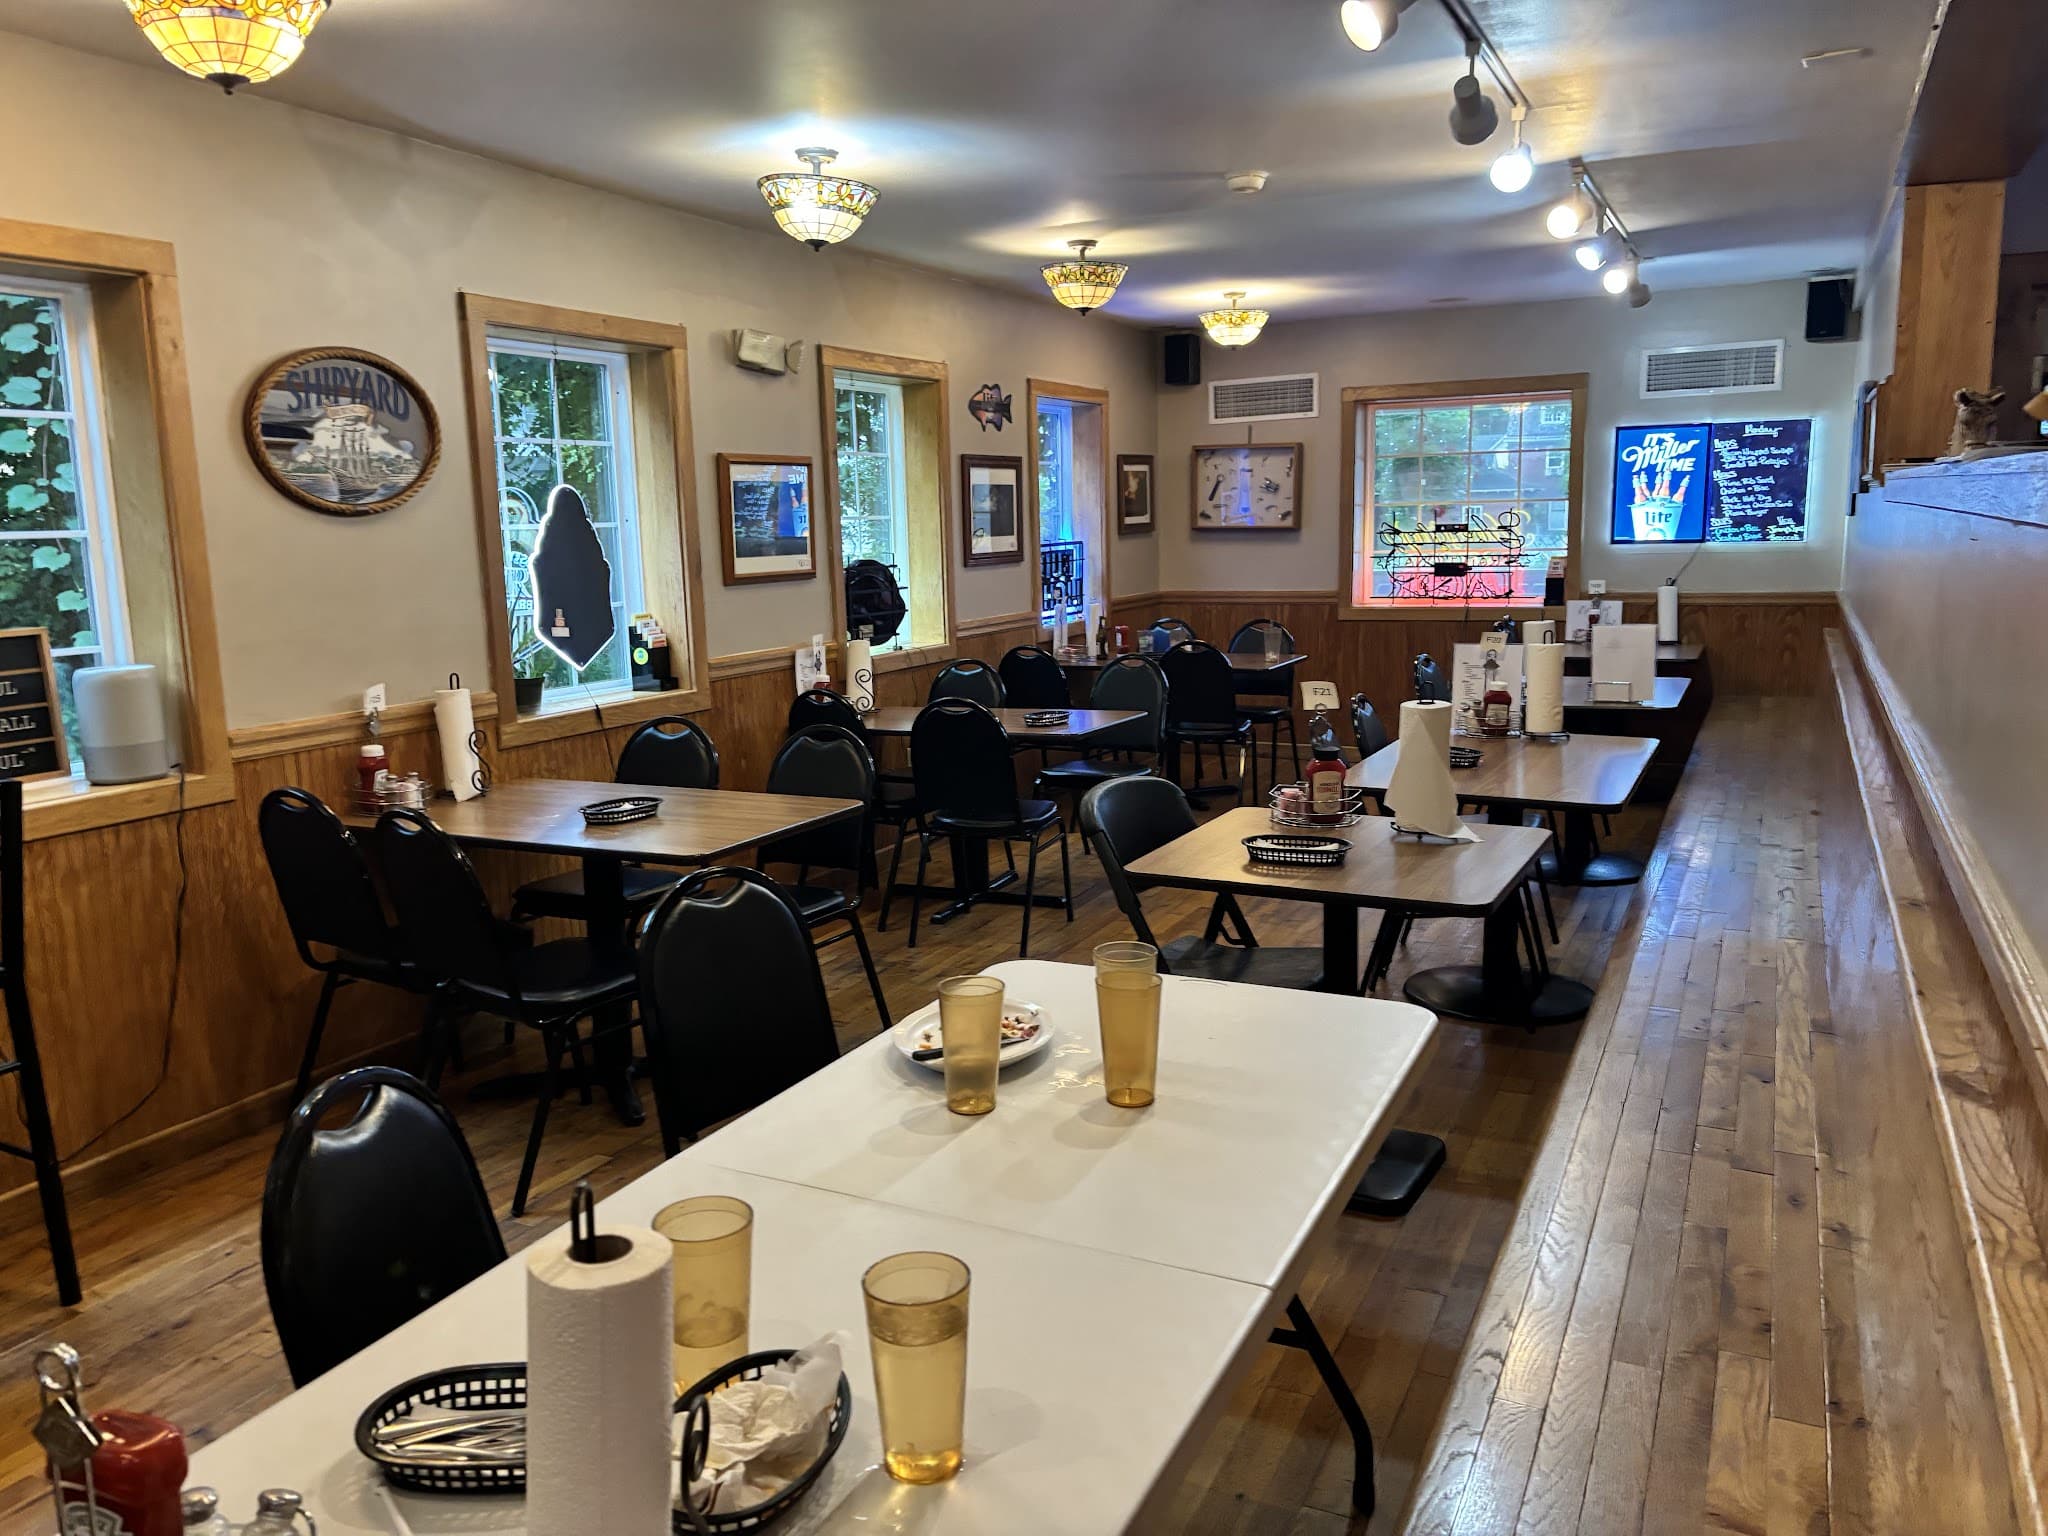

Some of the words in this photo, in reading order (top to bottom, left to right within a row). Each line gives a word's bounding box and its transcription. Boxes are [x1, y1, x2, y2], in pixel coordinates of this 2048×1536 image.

[286, 366, 410, 422] SHIPYARD
[1643, 432, 1676, 447] IT'S
[1622, 440, 1700, 472] Miller
[1656, 458, 1696, 472] TIME
[1646, 511, 1672, 526] Lite
